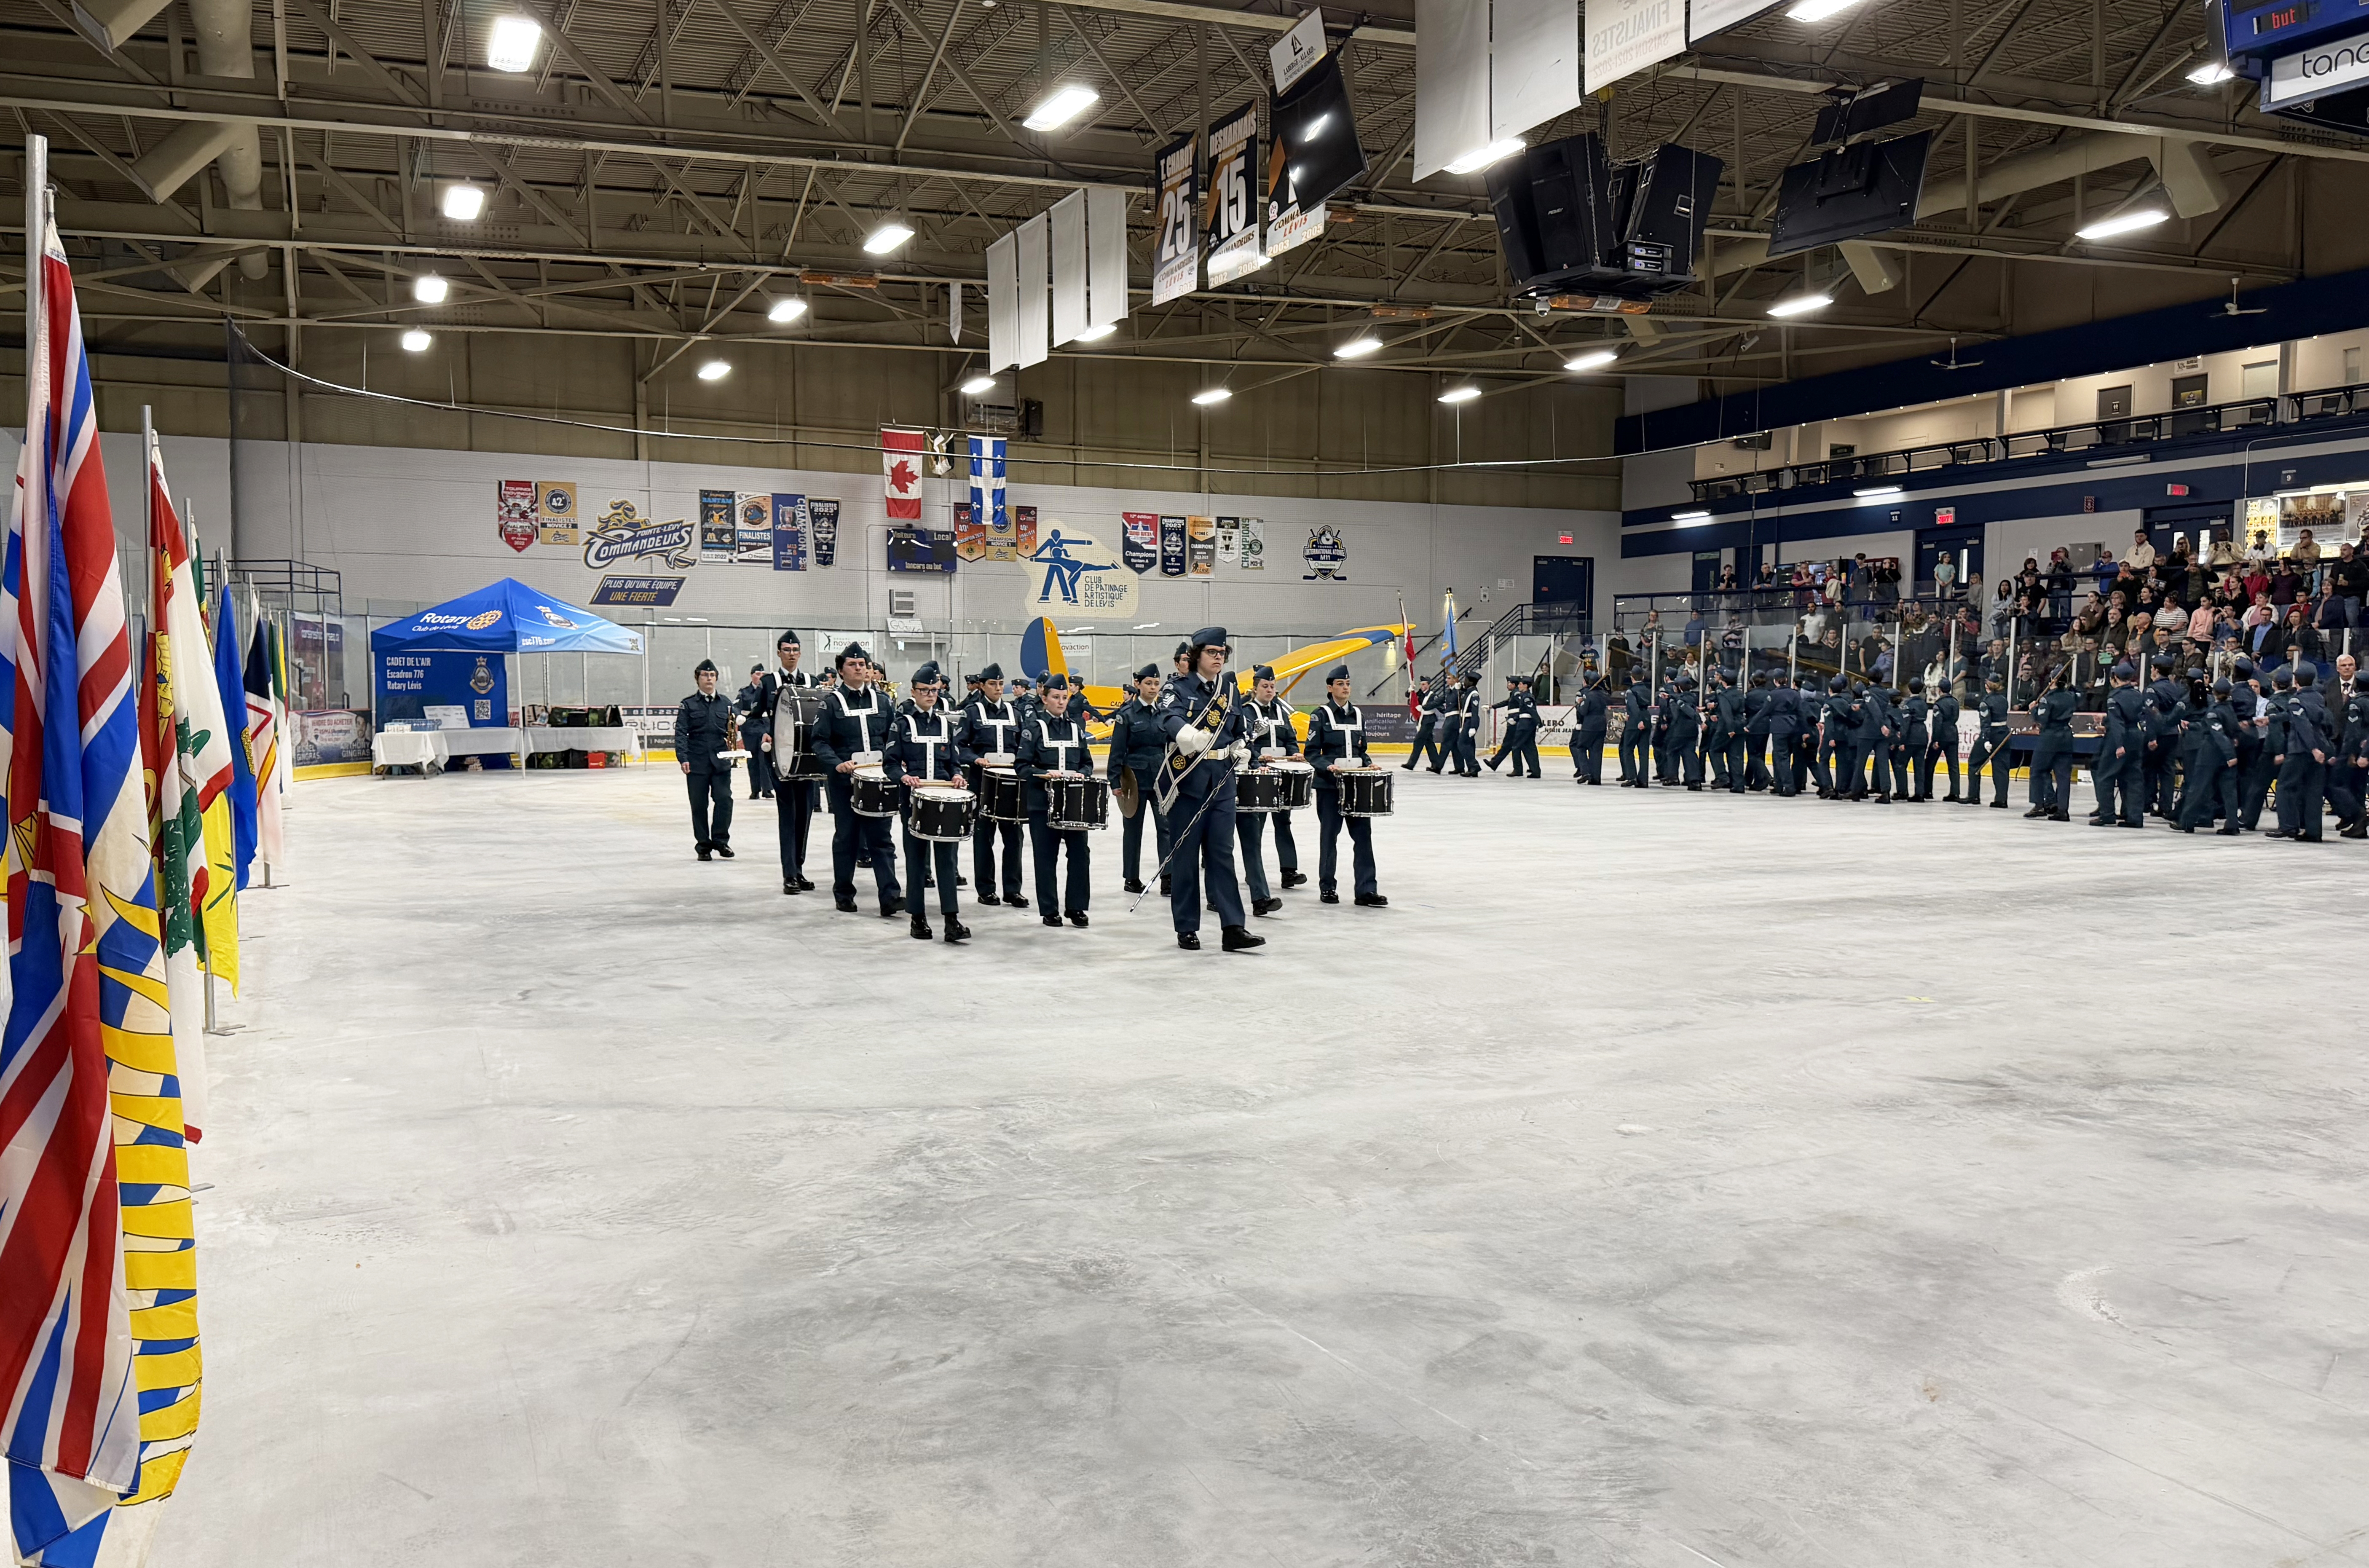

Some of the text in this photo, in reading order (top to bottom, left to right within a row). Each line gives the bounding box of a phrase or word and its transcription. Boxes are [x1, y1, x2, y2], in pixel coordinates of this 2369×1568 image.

[2272, 8, 2296, 29] but
[1209, 110, 1256, 158] DESHARNAIS
[1166, 143, 1193, 178] CHABOT
[1217, 155, 1246, 240] 15
[1161, 181, 1191, 262] 25
[1274, 209, 1301, 231] COMMA
[1284, 214, 1308, 237] LÉVIS
[1267, 222, 1323, 257] 2003 2005
[1159, 254, 1194, 282] COMMANDEURS
[1209, 260, 1258, 287] 2002 2003
[1165, 271, 1184, 289] LÉVIS
[1155, 281, 1194, 304] 2012 2013
[810, 501, 837, 510] FINALISTES
[636, 523, 682, 538] POINTE-LÉVY
[797, 498, 806, 551] CHAMPION
[739, 531, 771, 540] FINALISTES
[934, 532, 951, 541] Local
[1241, 517, 1250, 568] CHAMPIONS
[587, 527, 692, 568] COMMANDEURS
[1125, 550, 1156, 558] Champions
[905, 561, 925, 569] lancers
[933, 562, 943, 570] but
[604, 579, 624, 588] PLUS
[624, 580, 651, 590] QU'UNE
[1085, 576, 1102, 584] CLUB
[1095, 584, 1128, 592] PATINAGE
[610, 591, 659, 602] UNE FIERTÉ
[1084, 592, 1123, 600] ARTISTIQUE
[420, 612, 473, 625] Rotary
[386, 657, 431, 666] CADET DE L'AIR
[386, 669, 424, 678] Escadron 776
[387, 680, 422, 691] Rotary Lévis
[297, 752, 320, 761] GINGRAS
[341, 749, 370, 758] GINGRAS
